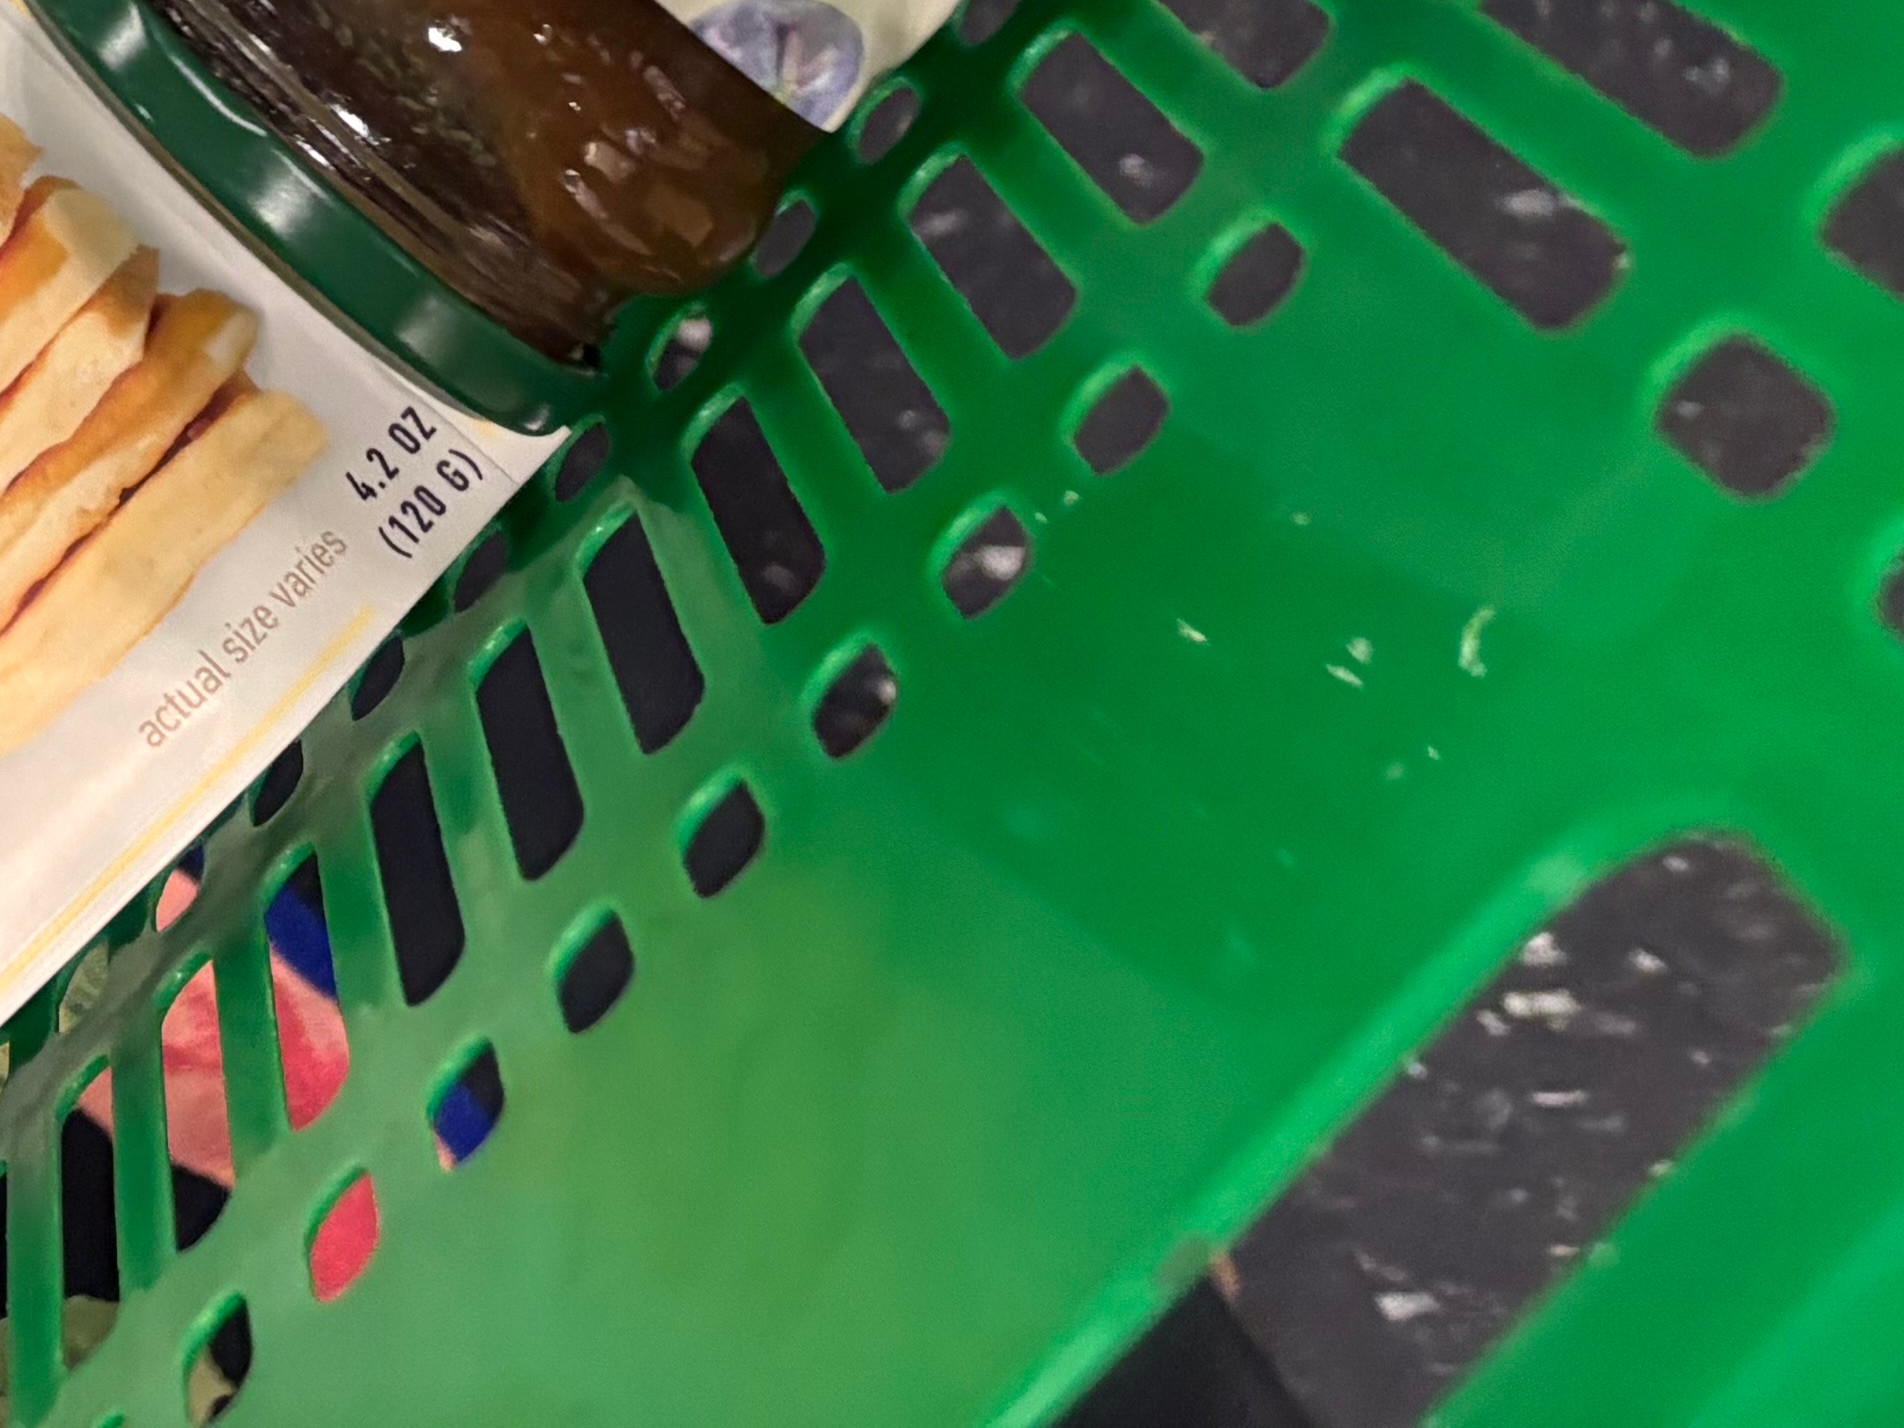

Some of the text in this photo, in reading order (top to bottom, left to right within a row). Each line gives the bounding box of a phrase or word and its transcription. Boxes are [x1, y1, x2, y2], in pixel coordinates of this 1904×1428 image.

[346, 407, 436, 500] 4.2 OZ
[379, 450, 482, 558] (120 G)
[139, 531, 348, 746] actual size varies
